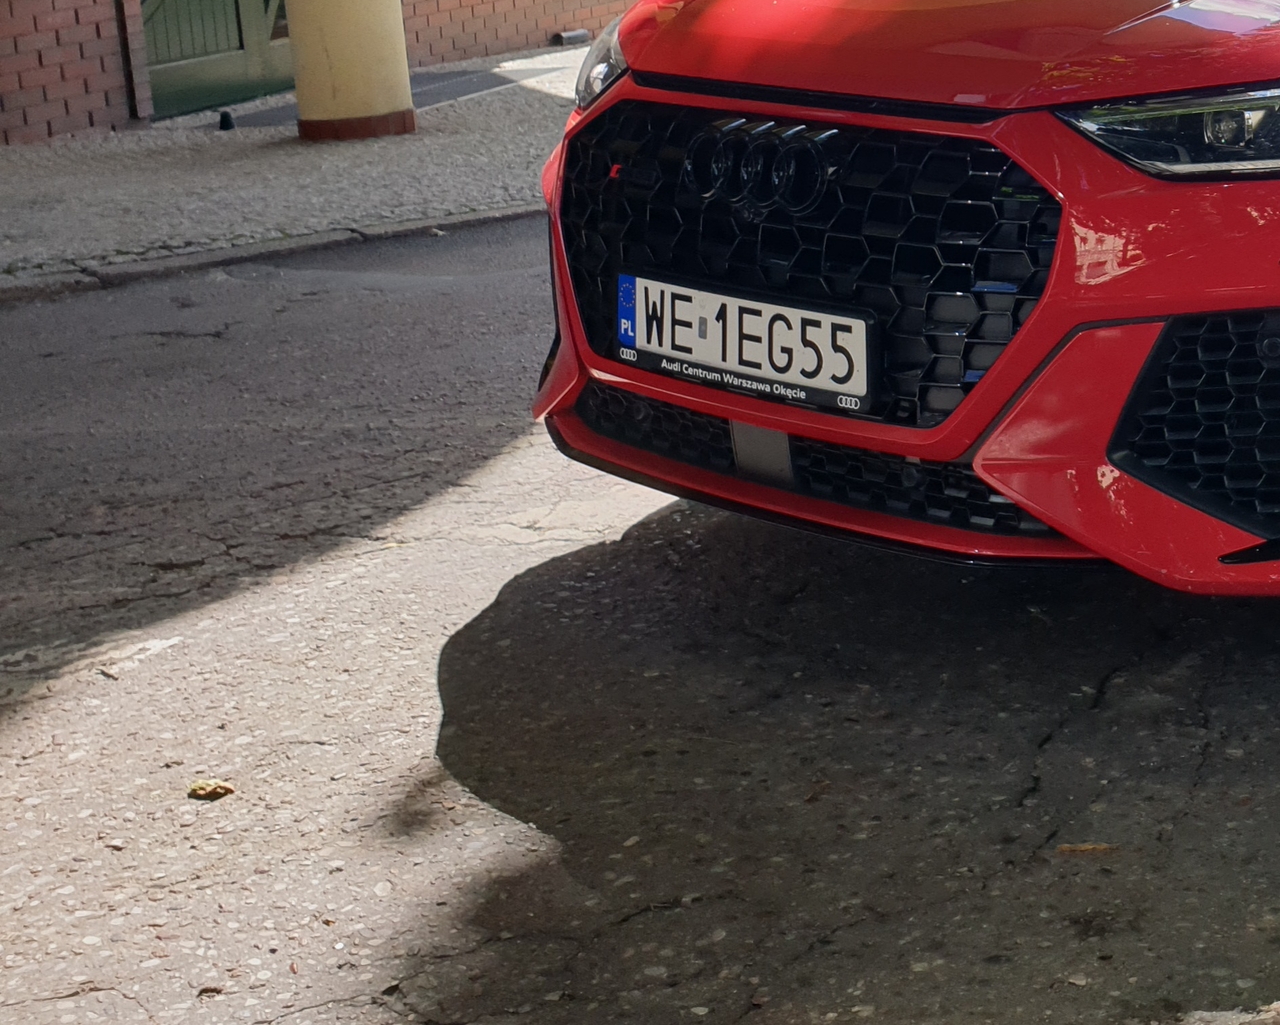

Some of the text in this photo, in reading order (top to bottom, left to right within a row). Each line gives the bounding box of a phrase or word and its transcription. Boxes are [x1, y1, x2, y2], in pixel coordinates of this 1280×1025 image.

[620, 286, 855, 385] PL WE 1EG55
[661, 358, 806, 400] Audi Centrum Warszawa Okęcie
